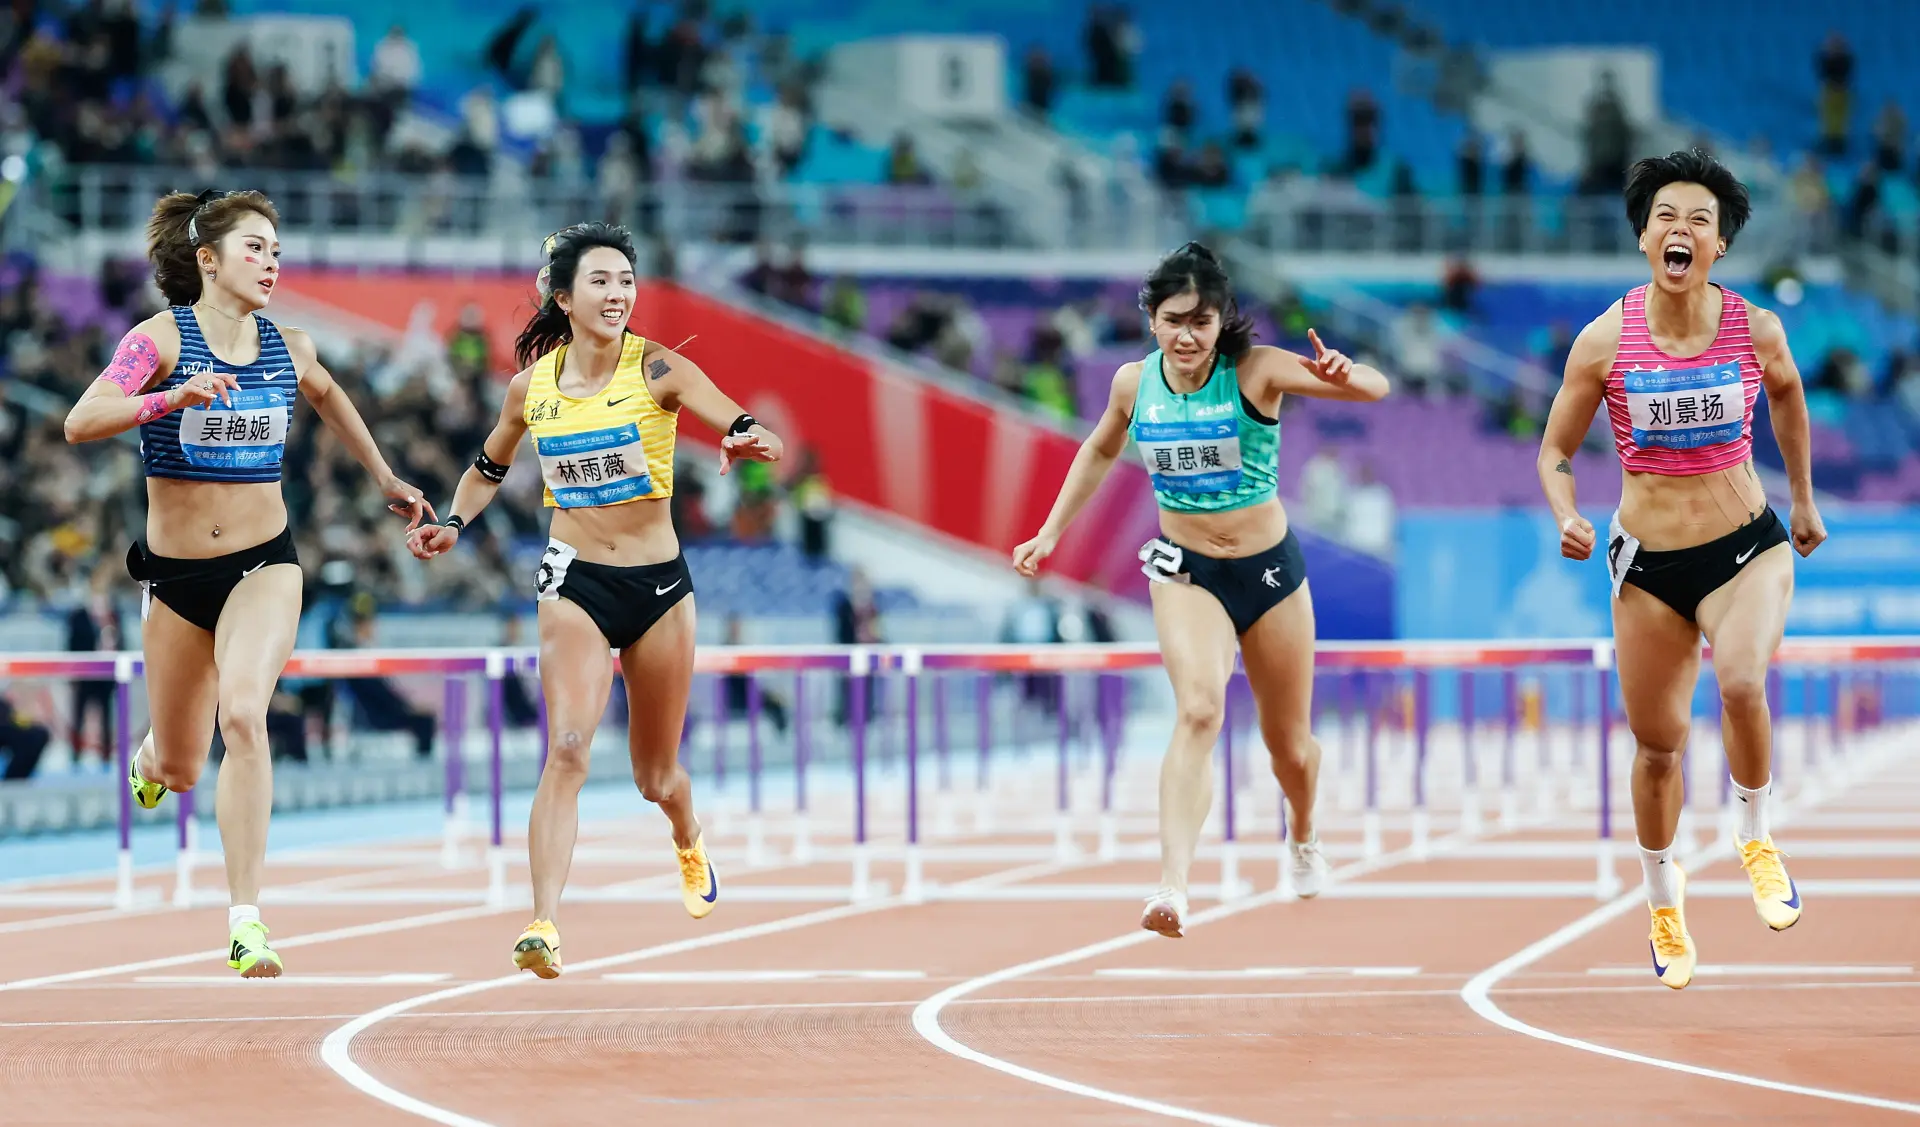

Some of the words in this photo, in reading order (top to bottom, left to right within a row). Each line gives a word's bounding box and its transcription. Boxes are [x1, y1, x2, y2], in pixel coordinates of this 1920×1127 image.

[1648, 394, 1724, 426] 刘景扬
[200, 415, 270, 442] 吴艳妮
[556, 452, 628, 484] 林雨薇
[1153, 444, 1222, 472] 夏思凝
